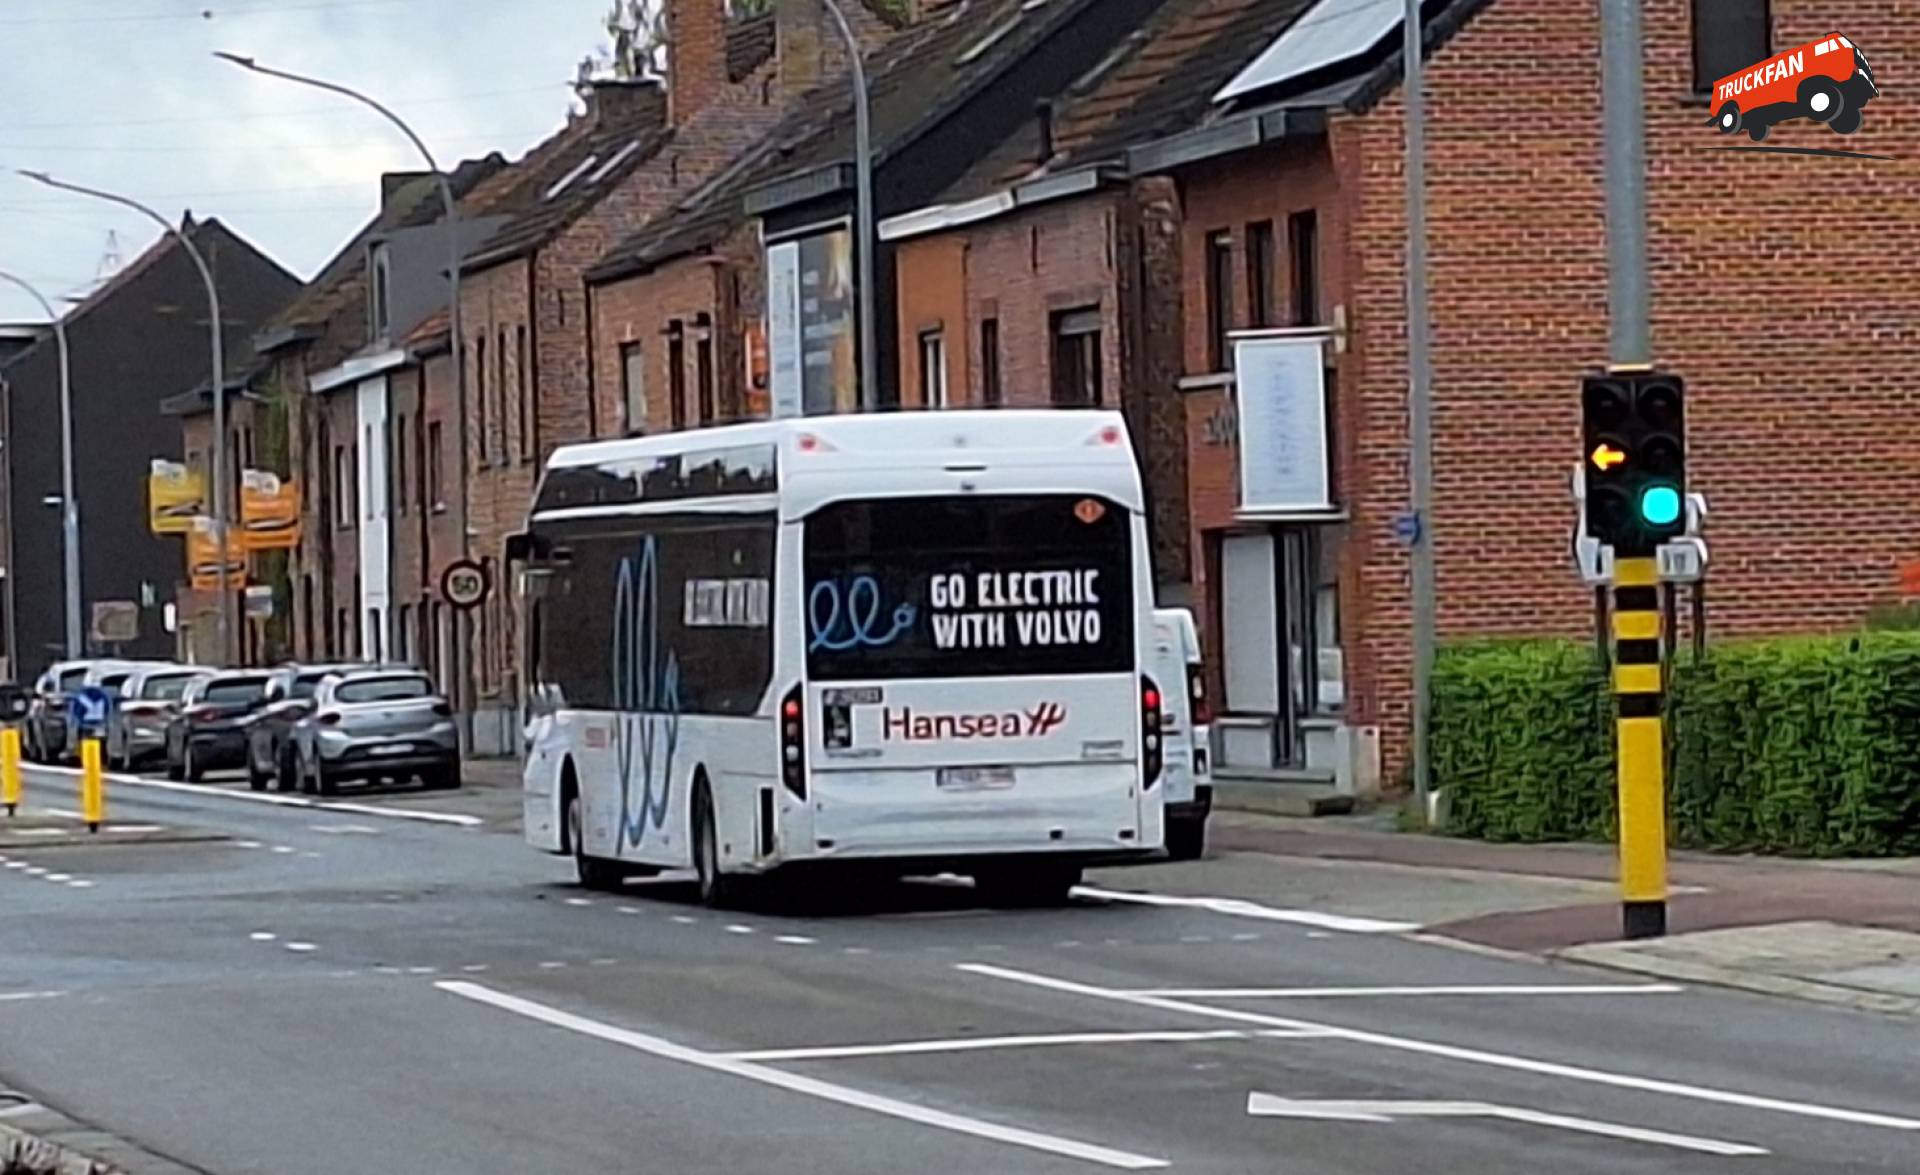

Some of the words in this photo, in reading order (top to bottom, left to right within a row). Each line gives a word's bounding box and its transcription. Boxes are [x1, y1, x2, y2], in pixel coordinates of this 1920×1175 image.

[931, 573, 966, 608] GO
[977, 568, 1099, 607] ELECTRIC
[932, 612, 1005, 648] WITH
[1015, 609, 1100, 645] VOLVO
[883, 706, 1021, 740] Hansea
